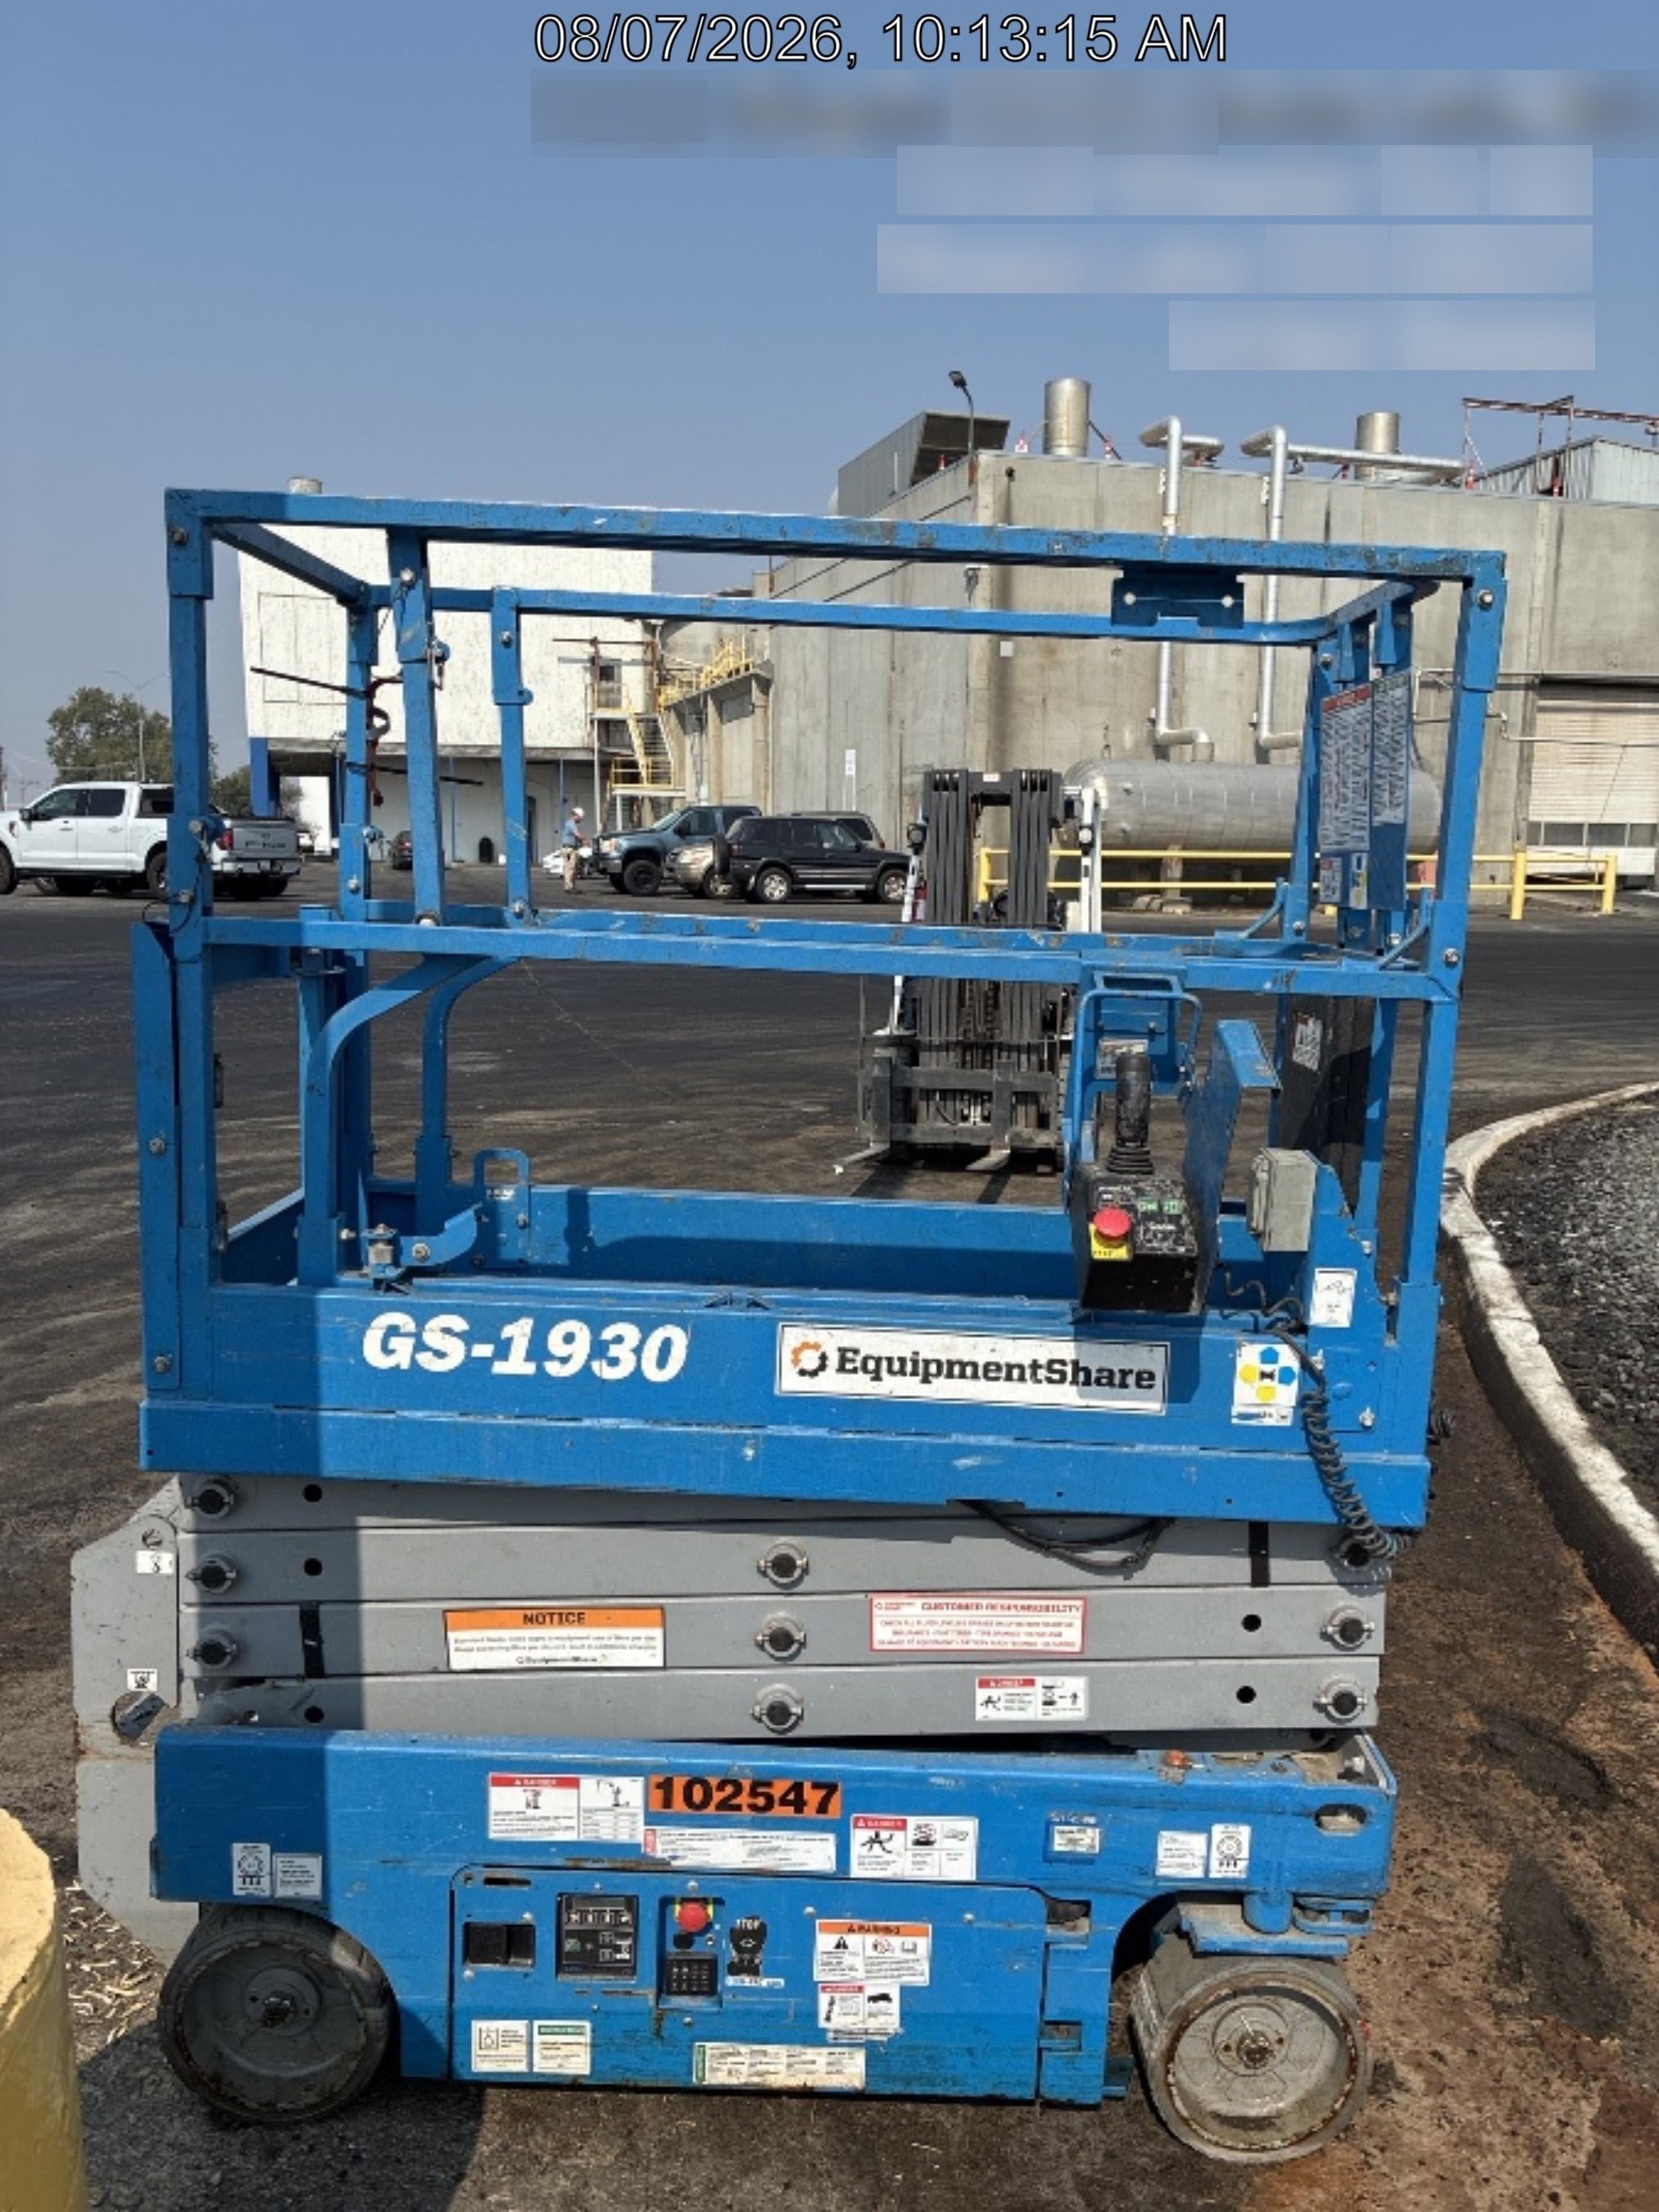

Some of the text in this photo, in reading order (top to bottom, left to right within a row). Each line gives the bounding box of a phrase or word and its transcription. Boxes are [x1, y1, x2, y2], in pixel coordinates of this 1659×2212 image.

[362, 1311, 690, 1383] GS-1930
[836, 1346, 1157, 1389] EquipmentShare
[523, 1612, 587, 1625] NOTICE
[655, 1776, 839, 1815] 102547
